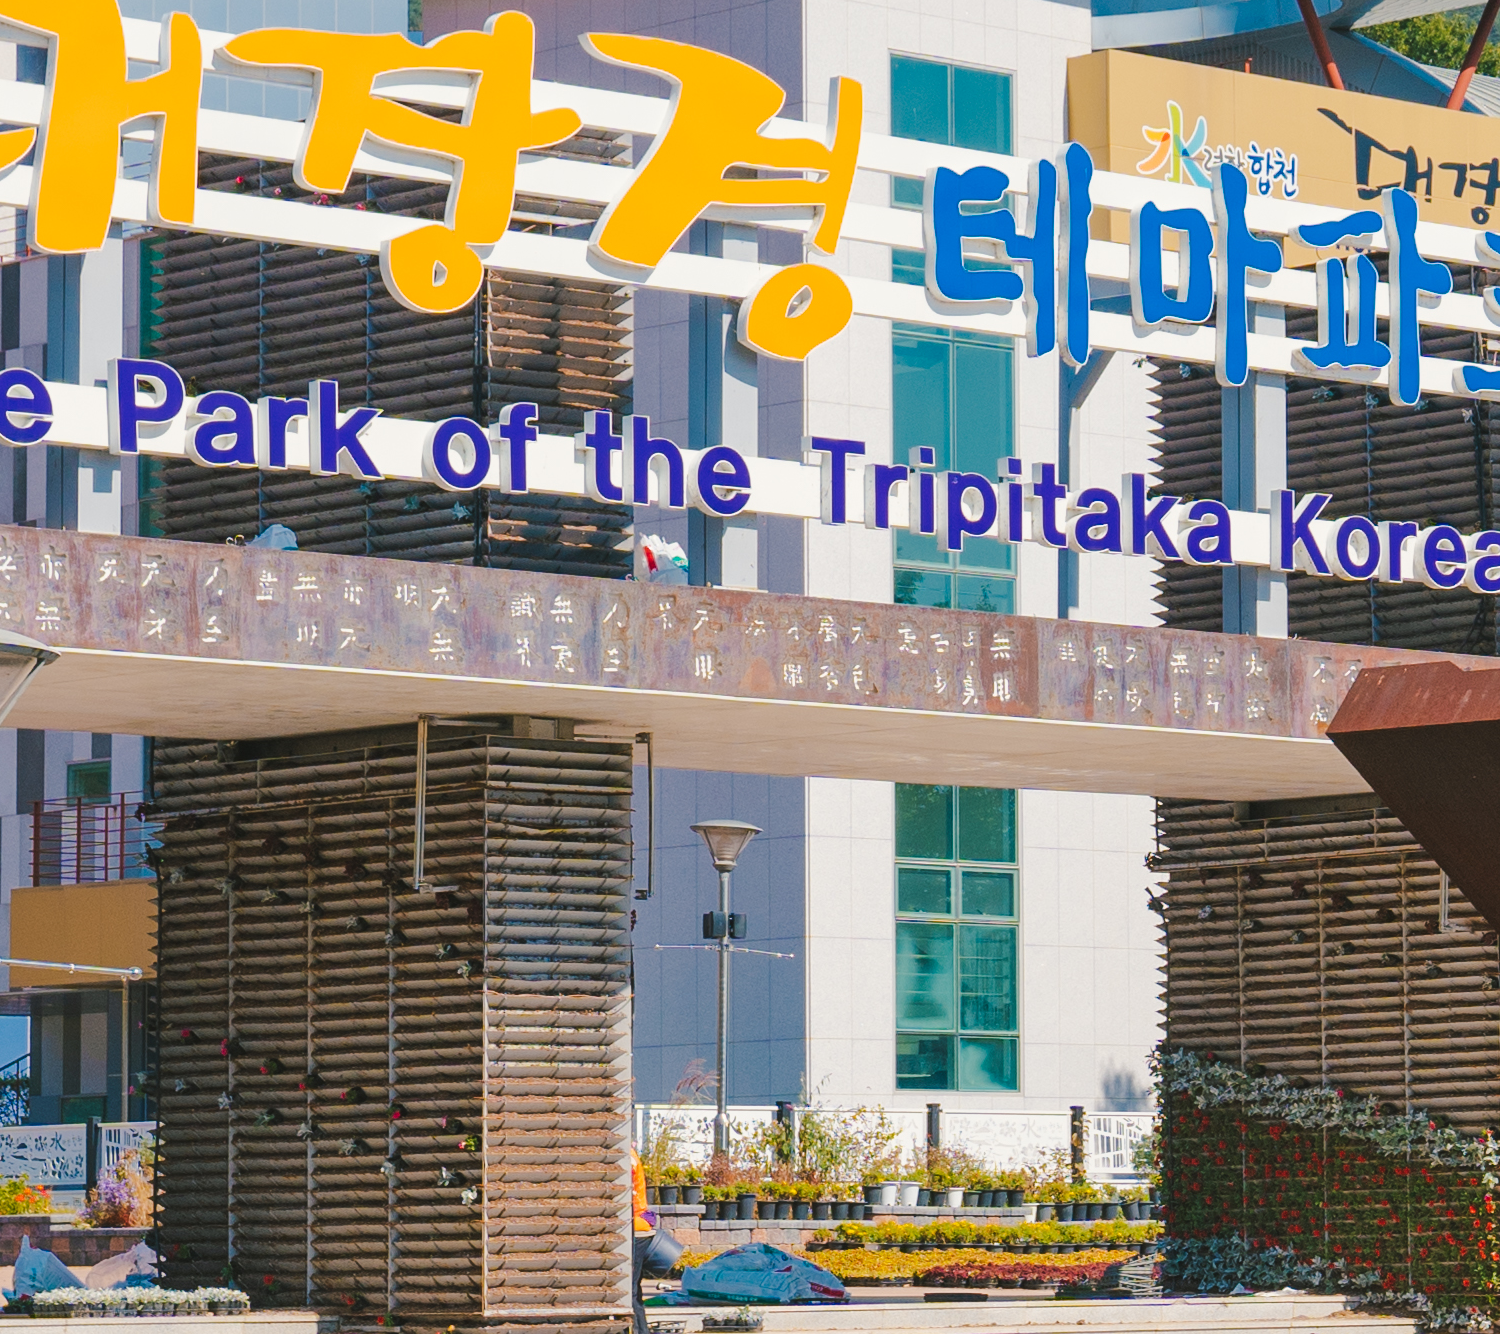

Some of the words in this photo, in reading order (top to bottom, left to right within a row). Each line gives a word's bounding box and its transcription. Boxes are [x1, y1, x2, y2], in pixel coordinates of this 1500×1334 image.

[1248, 142, 1298, 199] 합천
[114, 357, 381, 479] Park
[430, 402, 539, 493] of
[583, 410, 752, 517] the
[809, 435, 1234, 565] Tripitaka
